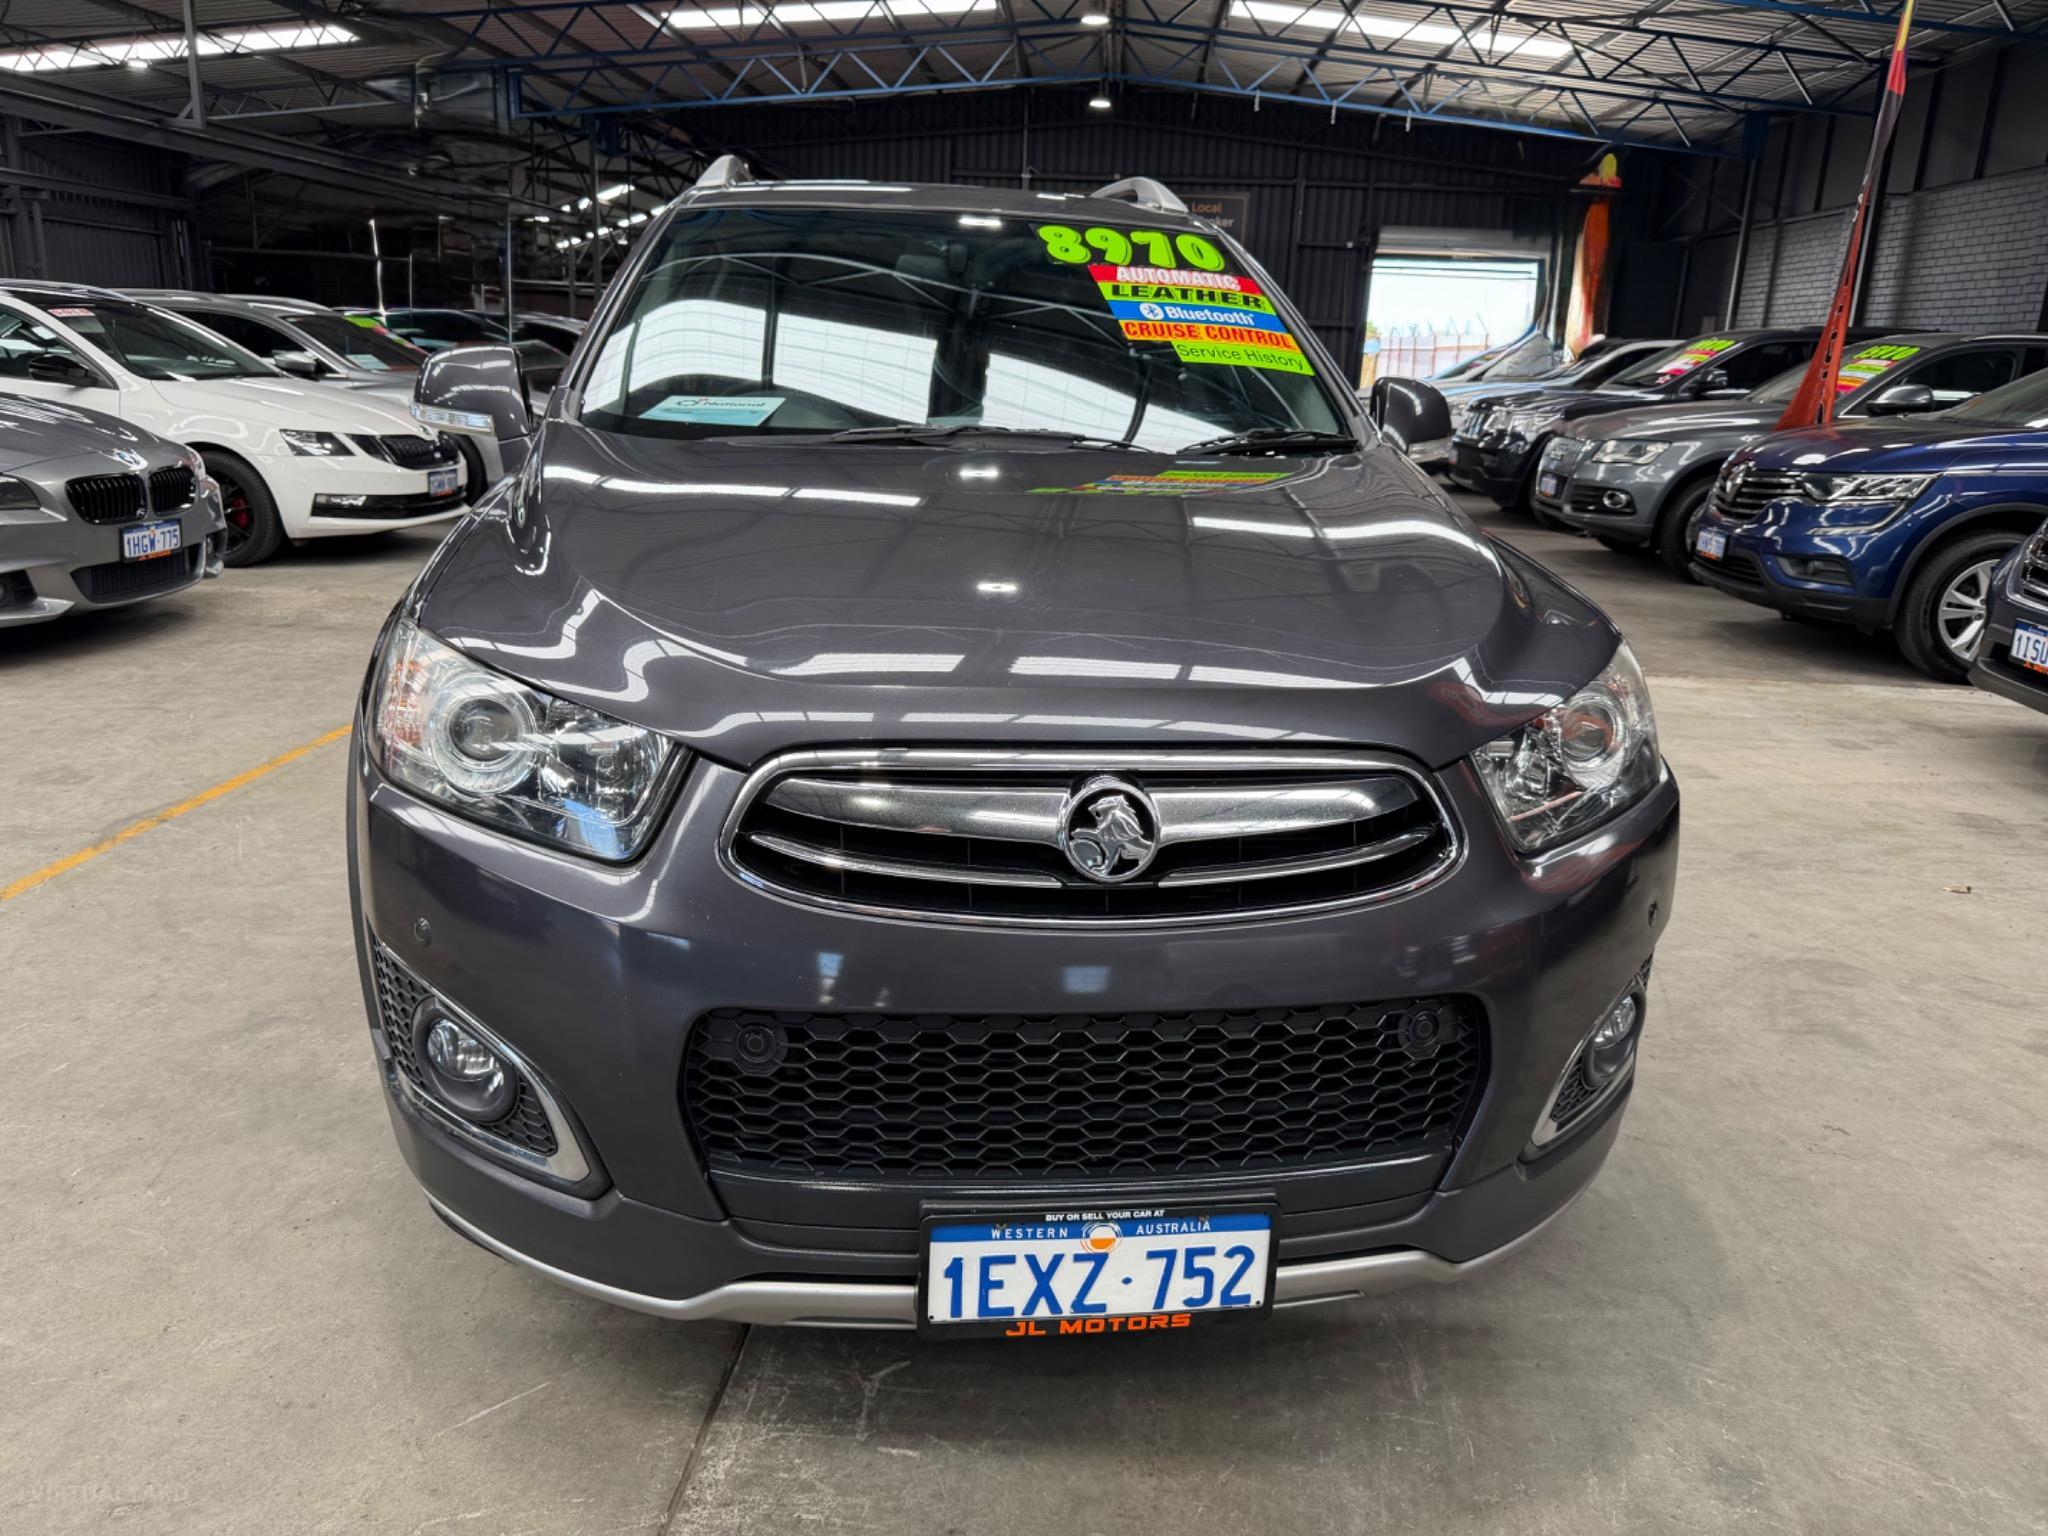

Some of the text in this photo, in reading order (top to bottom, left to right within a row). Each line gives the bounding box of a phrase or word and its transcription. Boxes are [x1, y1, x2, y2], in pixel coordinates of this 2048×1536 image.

[1191, 201, 1222, 213] Local
[1037, 224, 1225, 271] 8970
[1116, 265, 1241, 291] AUTOMATIC
[1111, 284, 1264, 309] LEATHER
[1125, 320, 1293, 349] CRUISE CONTROL
[1176, 342, 1304, 371] Service History
[1045, 1209, 1165, 1222] BUY OR SELL YOUR CAR AT
[991, 1220, 1211, 1240] WESTERN AUSTRALIA
[1005, 1313, 1192, 1337] JL MOTORS
